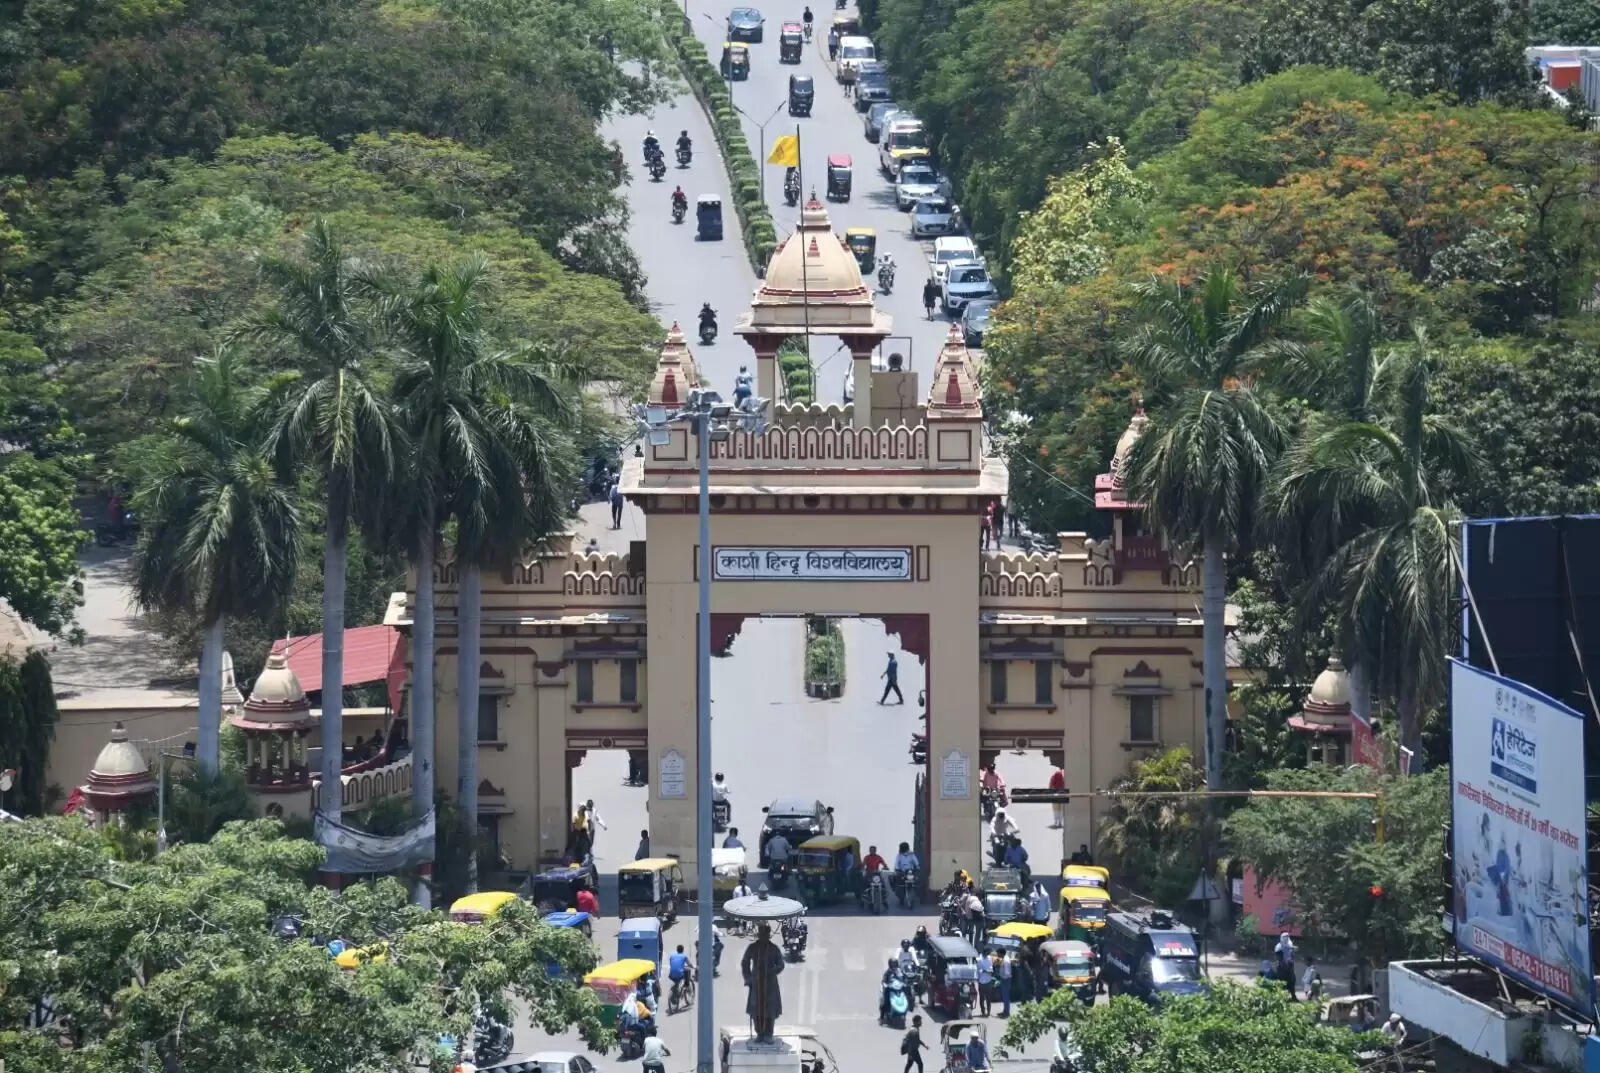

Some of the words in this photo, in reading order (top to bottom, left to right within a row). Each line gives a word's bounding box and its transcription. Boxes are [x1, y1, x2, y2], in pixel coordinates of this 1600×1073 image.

[720, 552, 759, 570] काशी
[766, 552, 801, 574] हिन्दू
[807, 551, 905, 570] विश्वविद्यालय
[1506, 724, 1536, 759] हेरिटेज
[1511, 945, 1570, 993] 0542-7181911
